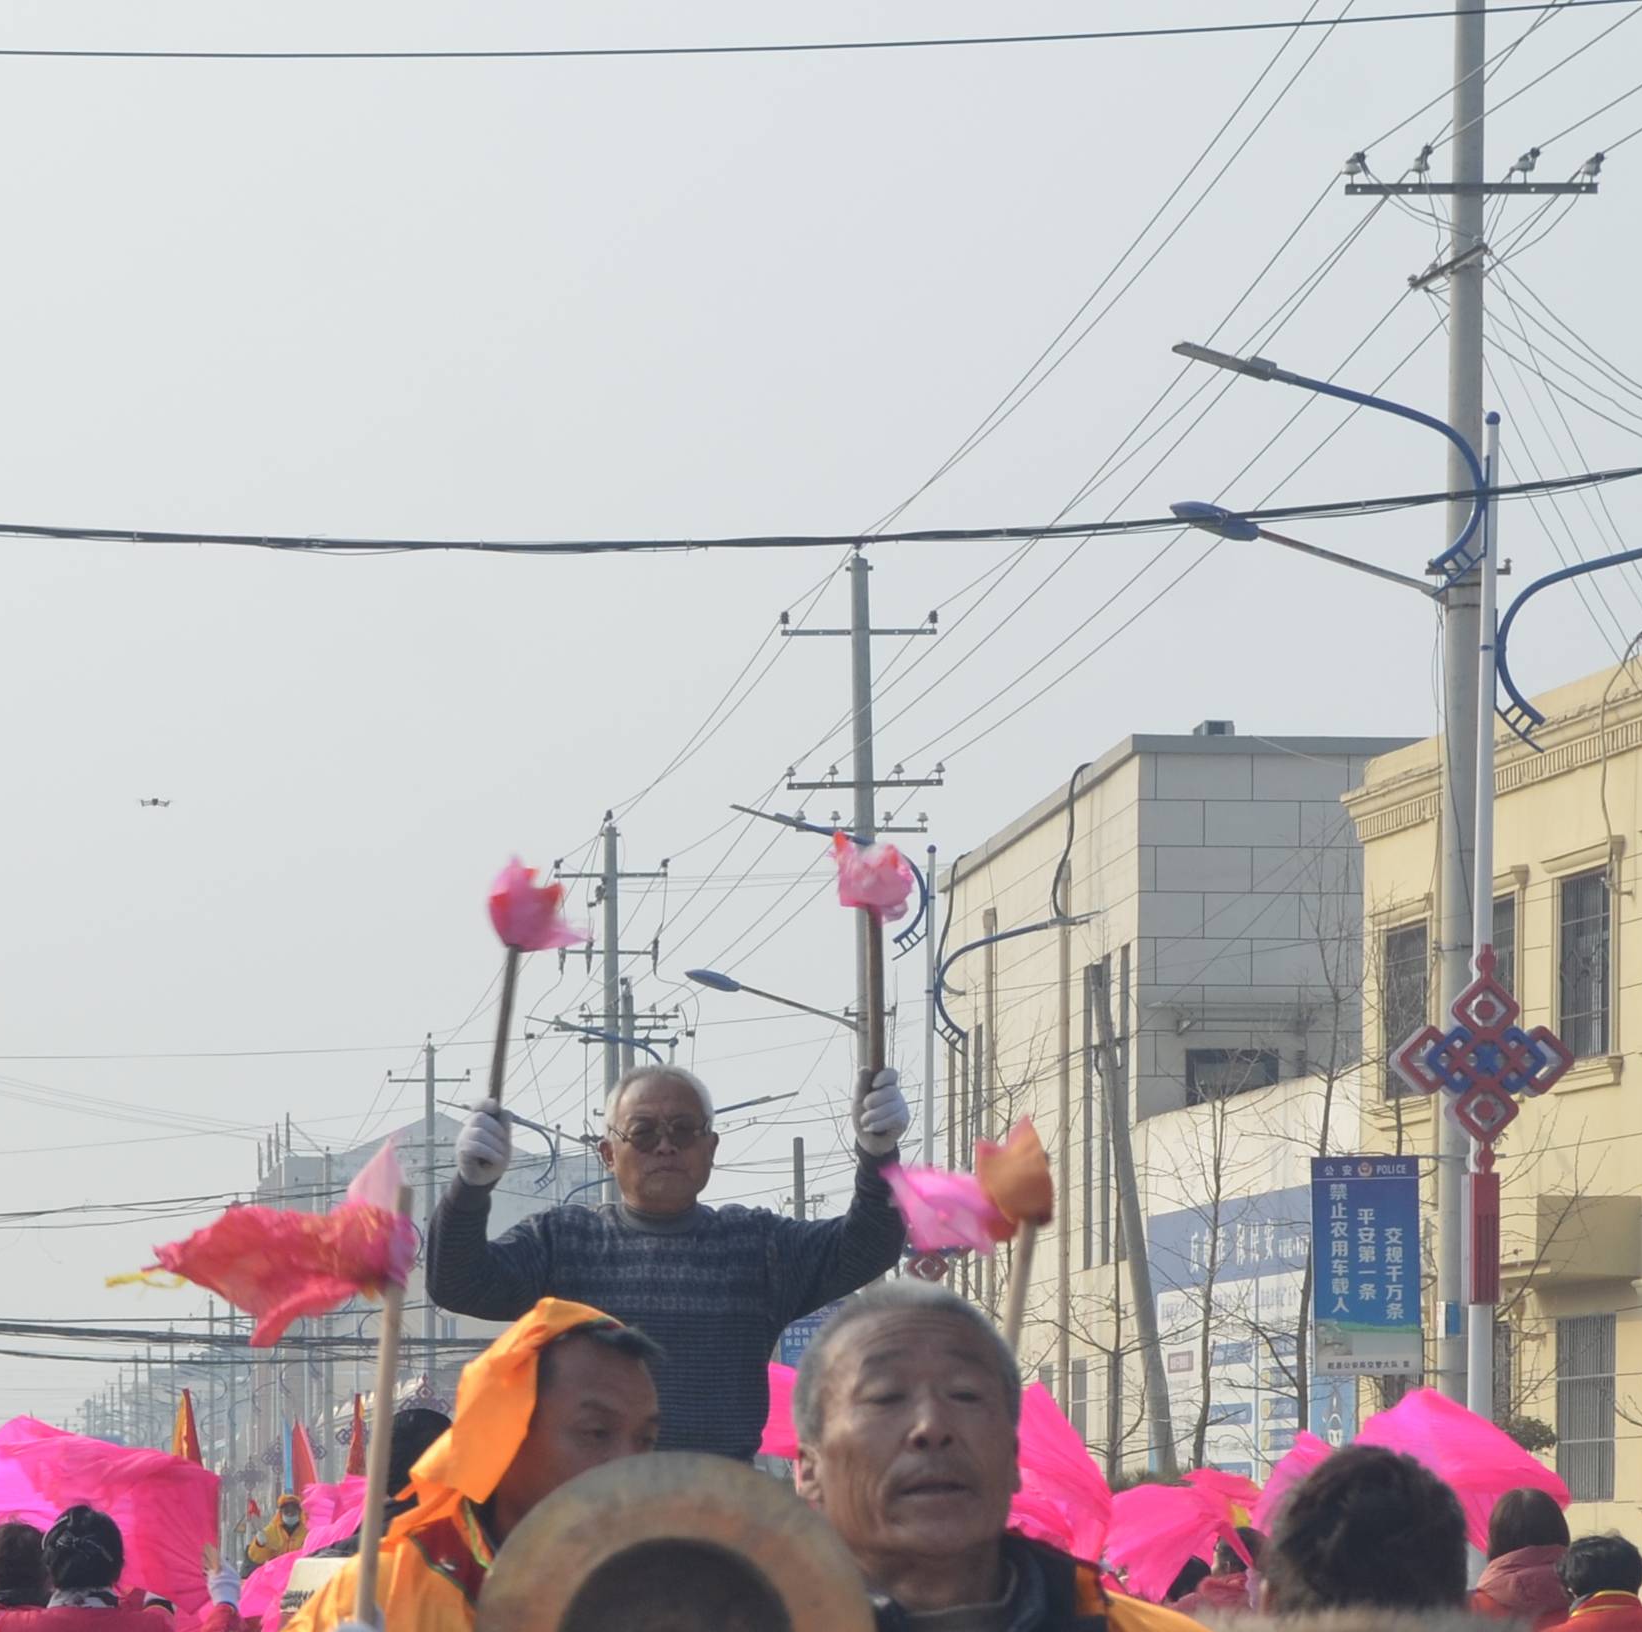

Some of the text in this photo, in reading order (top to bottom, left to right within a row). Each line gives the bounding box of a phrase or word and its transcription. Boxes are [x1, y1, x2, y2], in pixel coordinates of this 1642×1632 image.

[1375, 1164, 1407, 1175] POLICE
[1329, 1183, 1350, 1314] 禁止农用车载人
[1357, 1208, 1377, 1301] 平安第一条
[1384, 1227, 1404, 1320] 交规千万条
